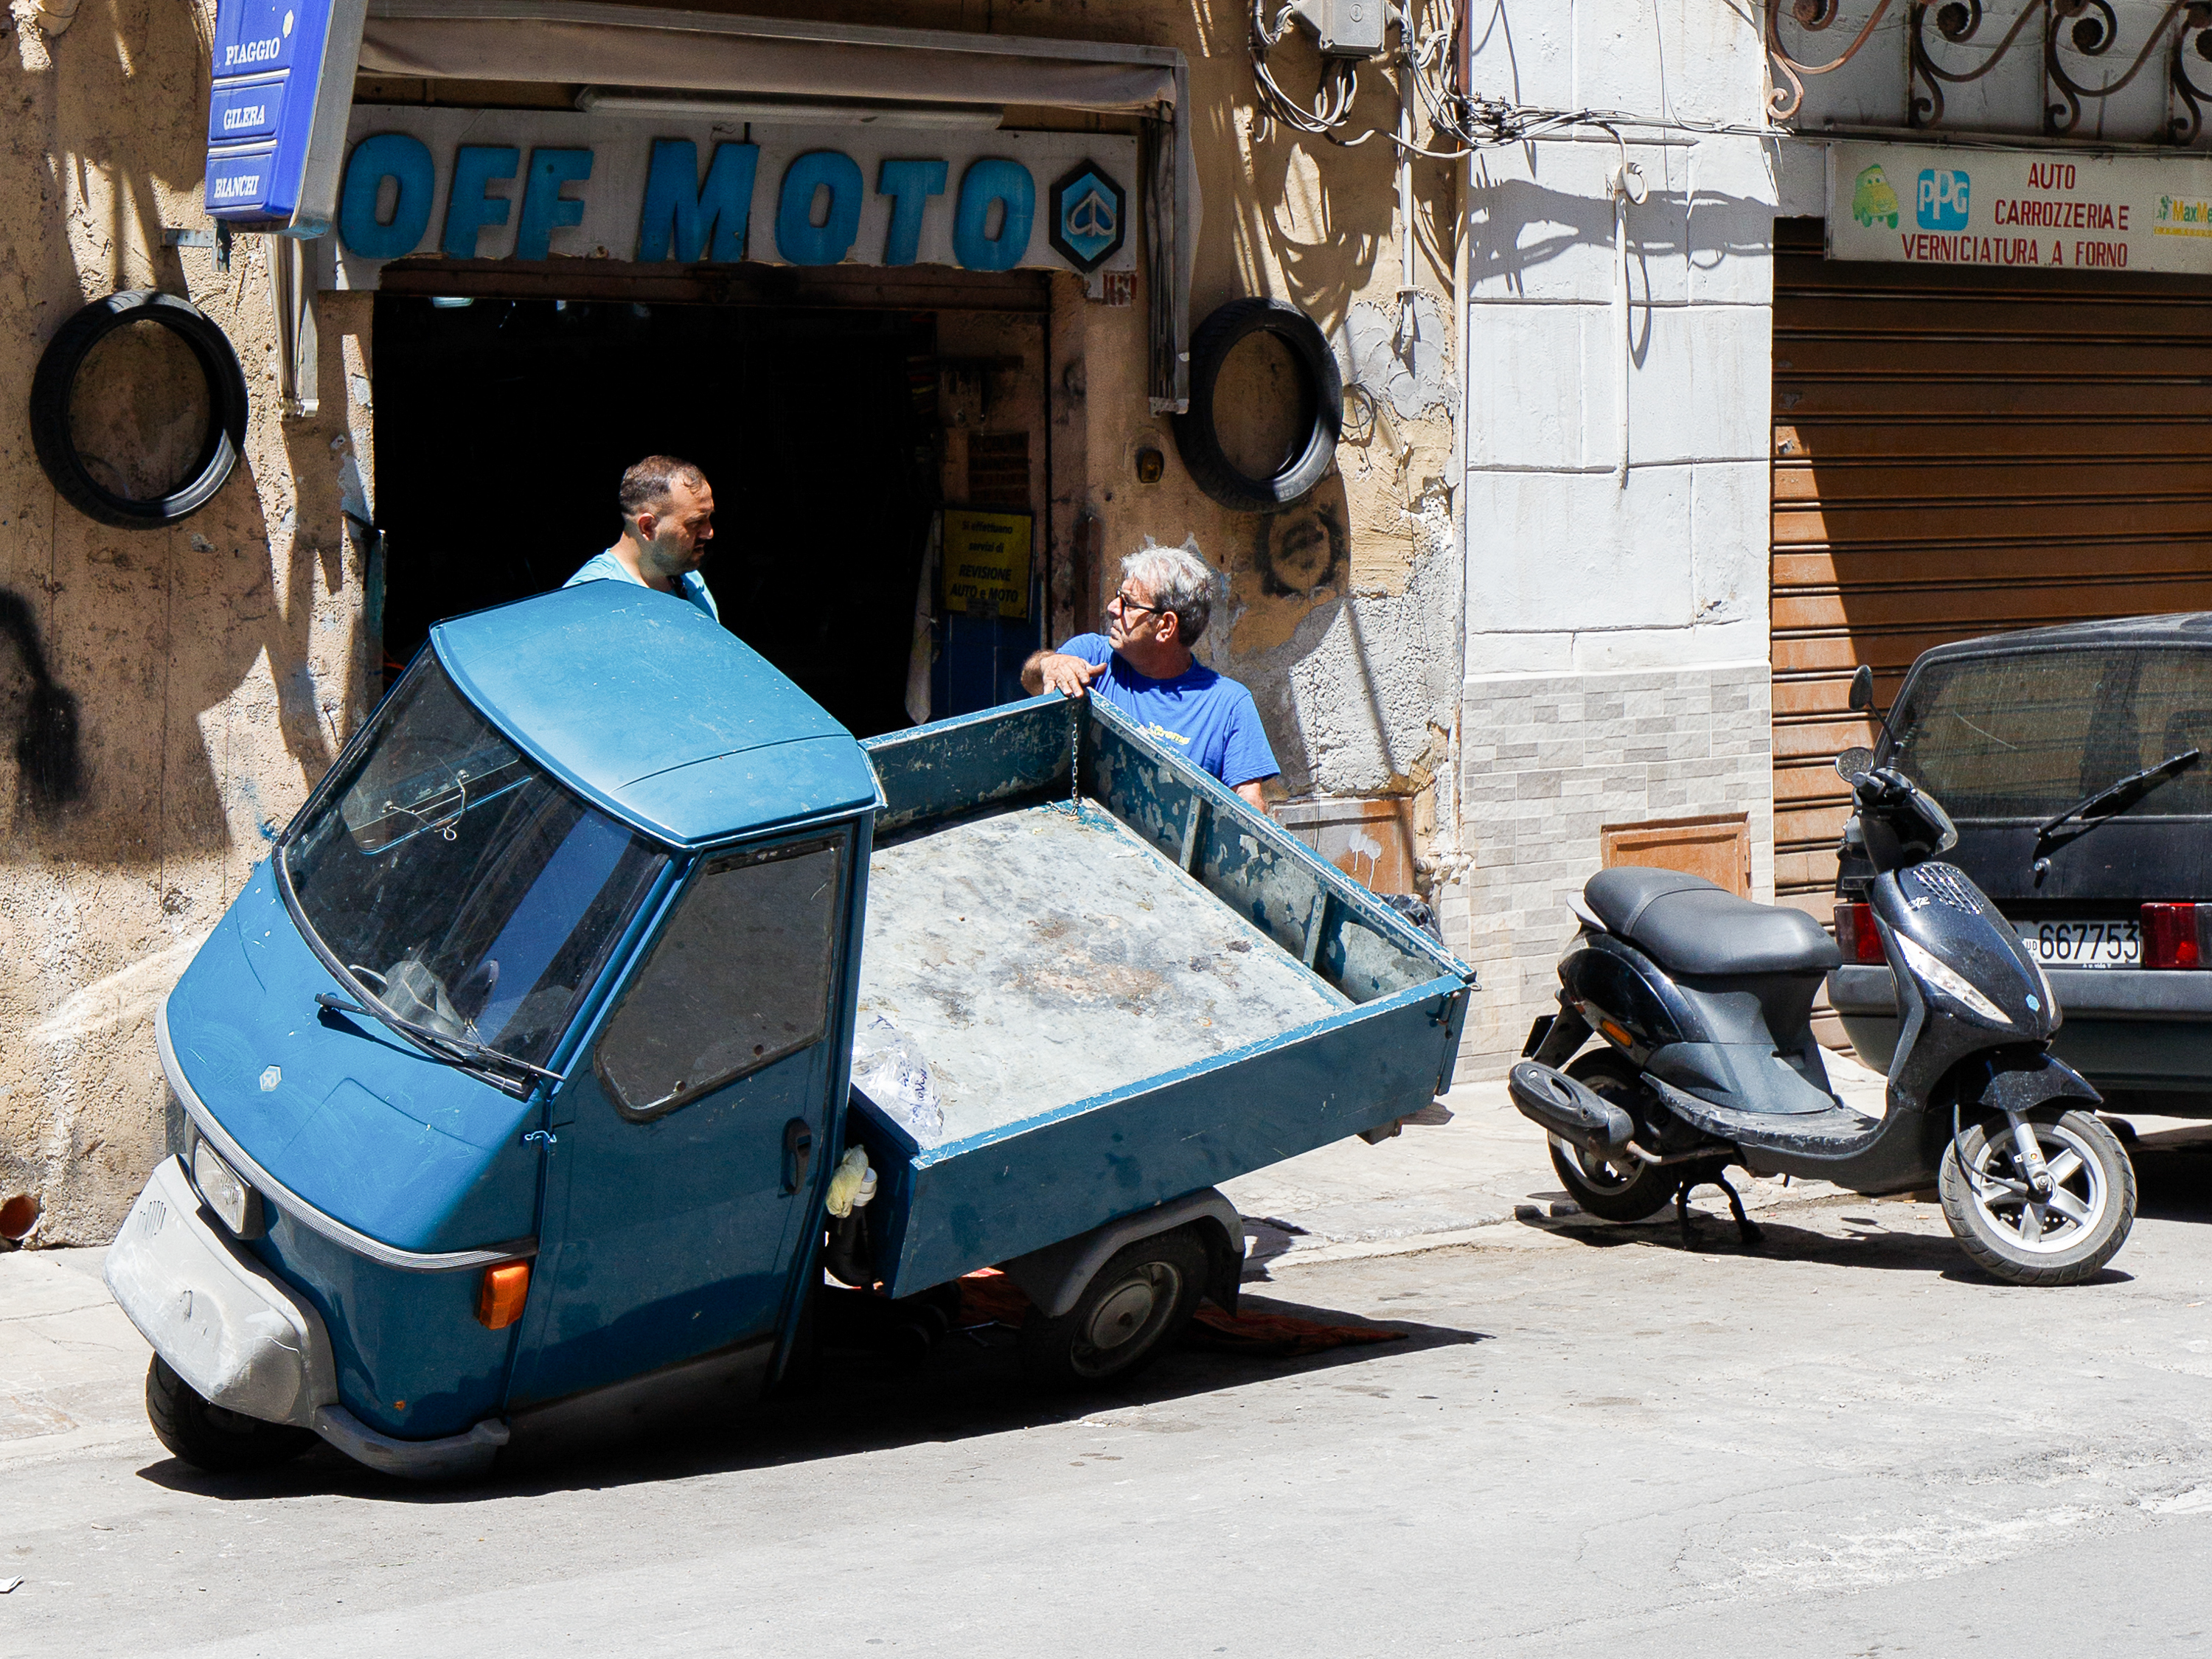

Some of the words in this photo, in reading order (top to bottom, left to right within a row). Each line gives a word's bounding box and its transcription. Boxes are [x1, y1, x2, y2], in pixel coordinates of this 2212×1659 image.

[225, 38, 280, 66] PIAGGIO
[223, 105, 265, 131] GILERA
[214, 175, 260, 198] BIANCHI
[2027, 162, 2076, 190] AUTO
[338, 133, 594, 260] OFF
[637, 140, 1037, 271] MOTO
[1918, 168, 1969, 220] PPG
[1994, 199, 2115, 230] CARROZZERIA
[2118, 205, 2130, 231] E
[1901, 233, 2039, 265] VERNICIATURA
[2051, 240, 2064, 265] A
[2076, 241, 2129, 268] FORNO
[961, 521, 970, 530] Si
[971, 521, 1013, 534] effettuano
[968, 542, 995, 552] servizi
[996, 542, 1004, 553] di
[959, 564, 1012, 582] REVISIONE
[949, 583, 978, 599] AUTO
[979, 589, 986, 599] e
[988, 587, 1019, 603] MOTO
[2039, 923, 2139, 960] 667753
